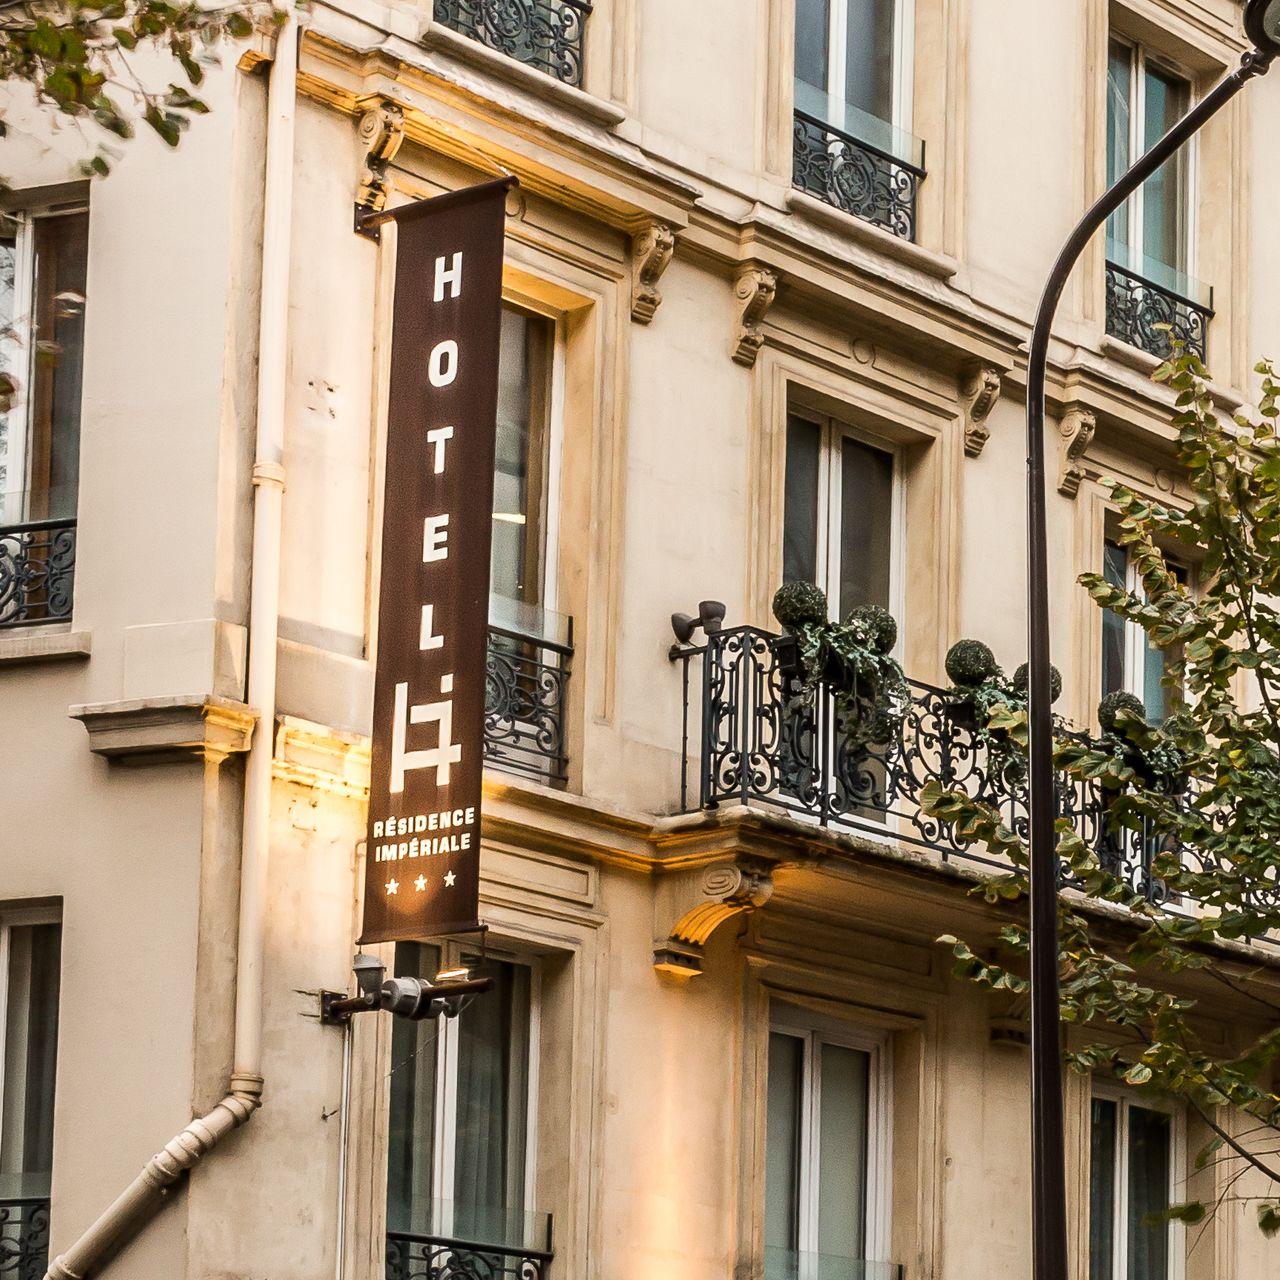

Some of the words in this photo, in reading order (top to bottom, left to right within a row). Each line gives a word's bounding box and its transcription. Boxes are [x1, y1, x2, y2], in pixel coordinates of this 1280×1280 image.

[419, 251, 463, 651] HOTEL
[373, 807, 475, 839] RÉSIDENCE
[375, 833, 471, 863] IMPÉRIALE
